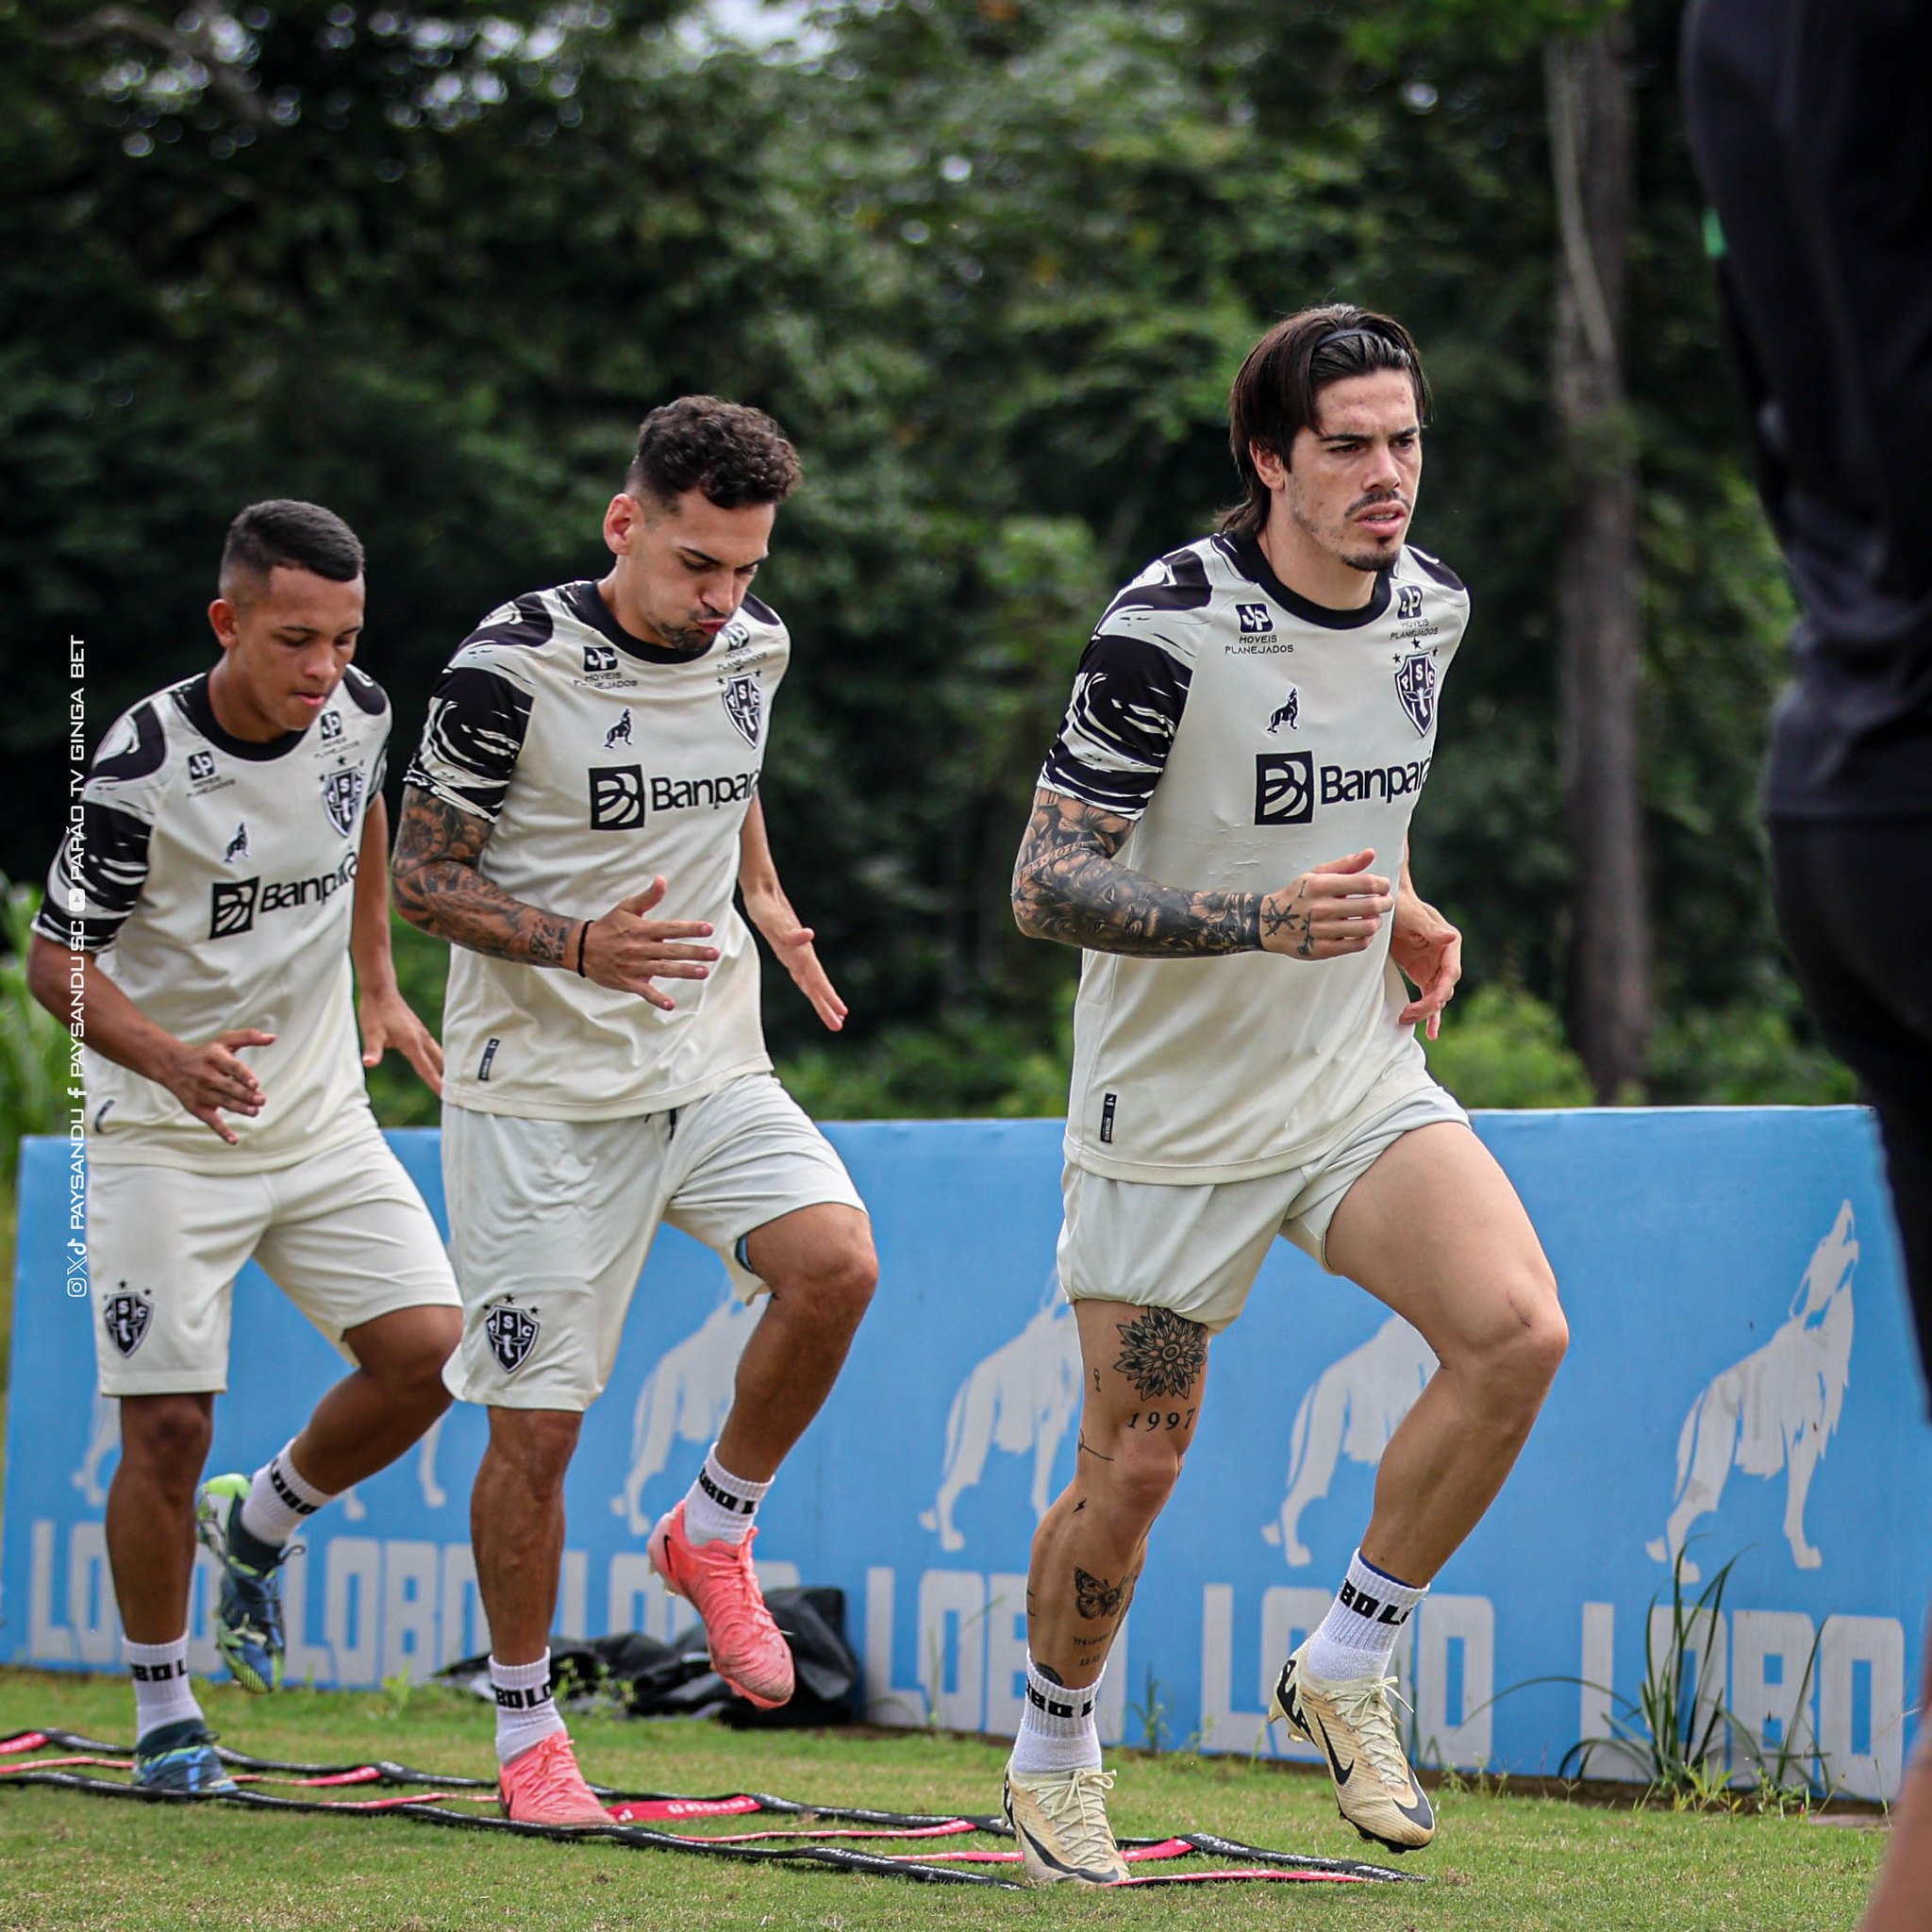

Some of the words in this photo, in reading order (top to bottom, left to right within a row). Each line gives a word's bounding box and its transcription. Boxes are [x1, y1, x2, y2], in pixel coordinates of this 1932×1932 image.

[1238, 635, 1278, 644] MOVEIS
[1389, 625, 1439, 641] PLANEJADOS
[1224, 644, 1295, 655] PLANEJADOS
[650, 769, 760, 812] Banpar
[1127, 1407, 1196, 1432] 1997
[1580, 1602, 1905, 1803] LOBO
